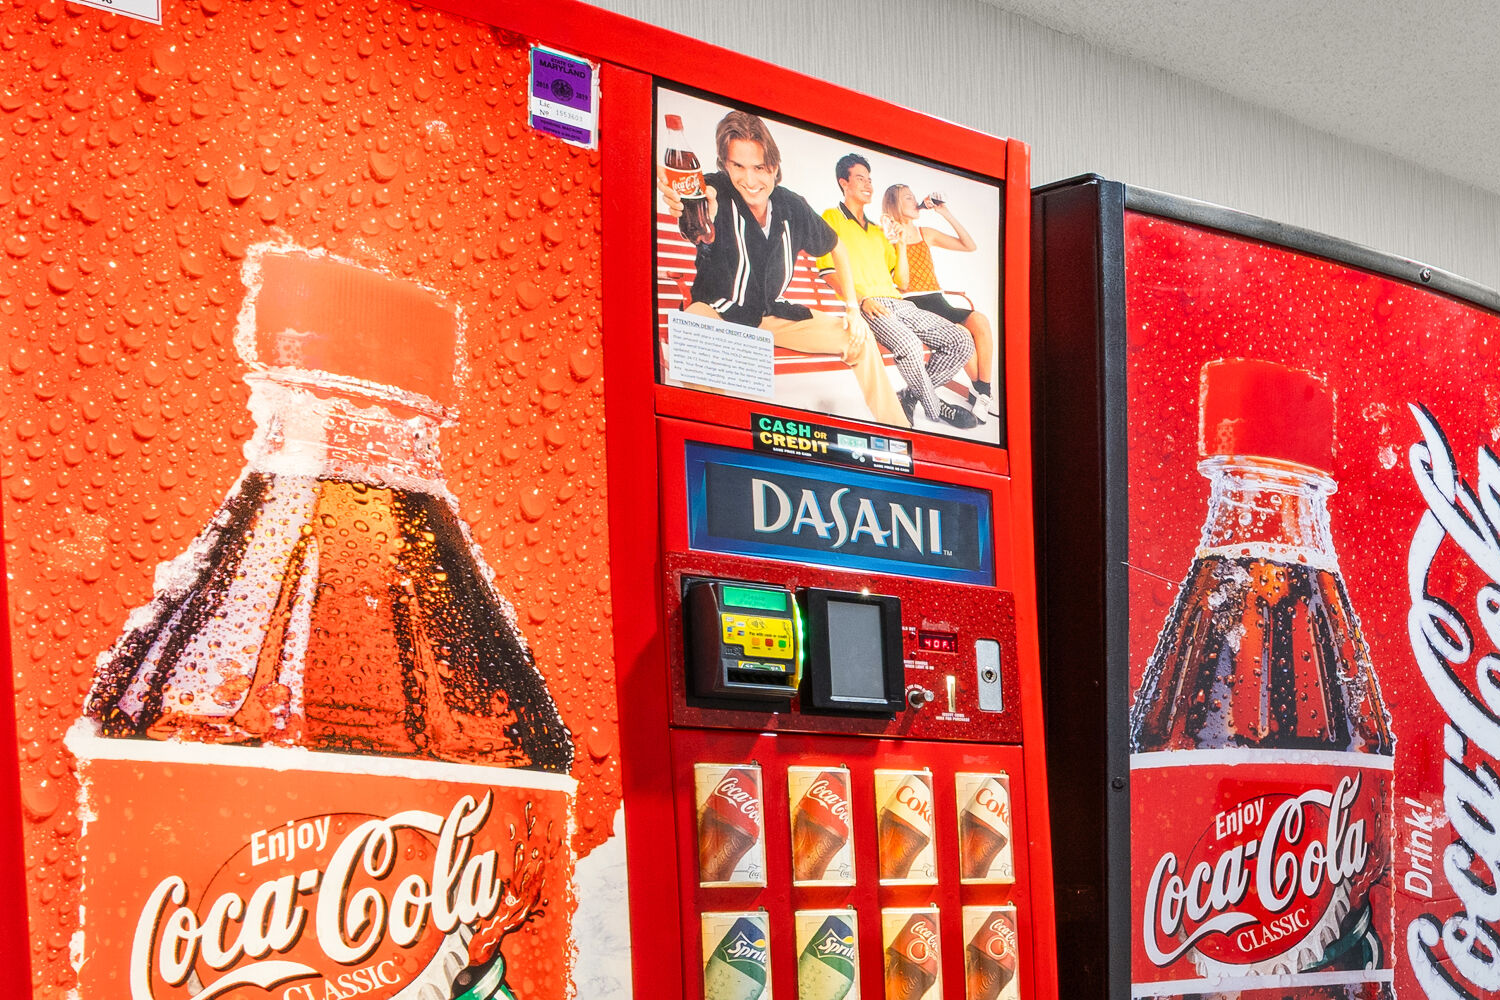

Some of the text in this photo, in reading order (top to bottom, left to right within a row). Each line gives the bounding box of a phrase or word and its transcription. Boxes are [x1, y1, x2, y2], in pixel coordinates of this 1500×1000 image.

[539, 59, 586, 79] MARYLAND
[759, 431, 830, 454] CREDIT
[813, 430, 828, 440] OR
[751, 477, 943, 556] DASANI
[249, 815, 331, 867] Enjoy
[1215, 797, 1265, 842] Enjoy
[1143, 770, 1368, 968] Coca-Cola
[1404, 796, 1434, 899] Drink!
[1236, 907, 1310, 953] CLASSIC
